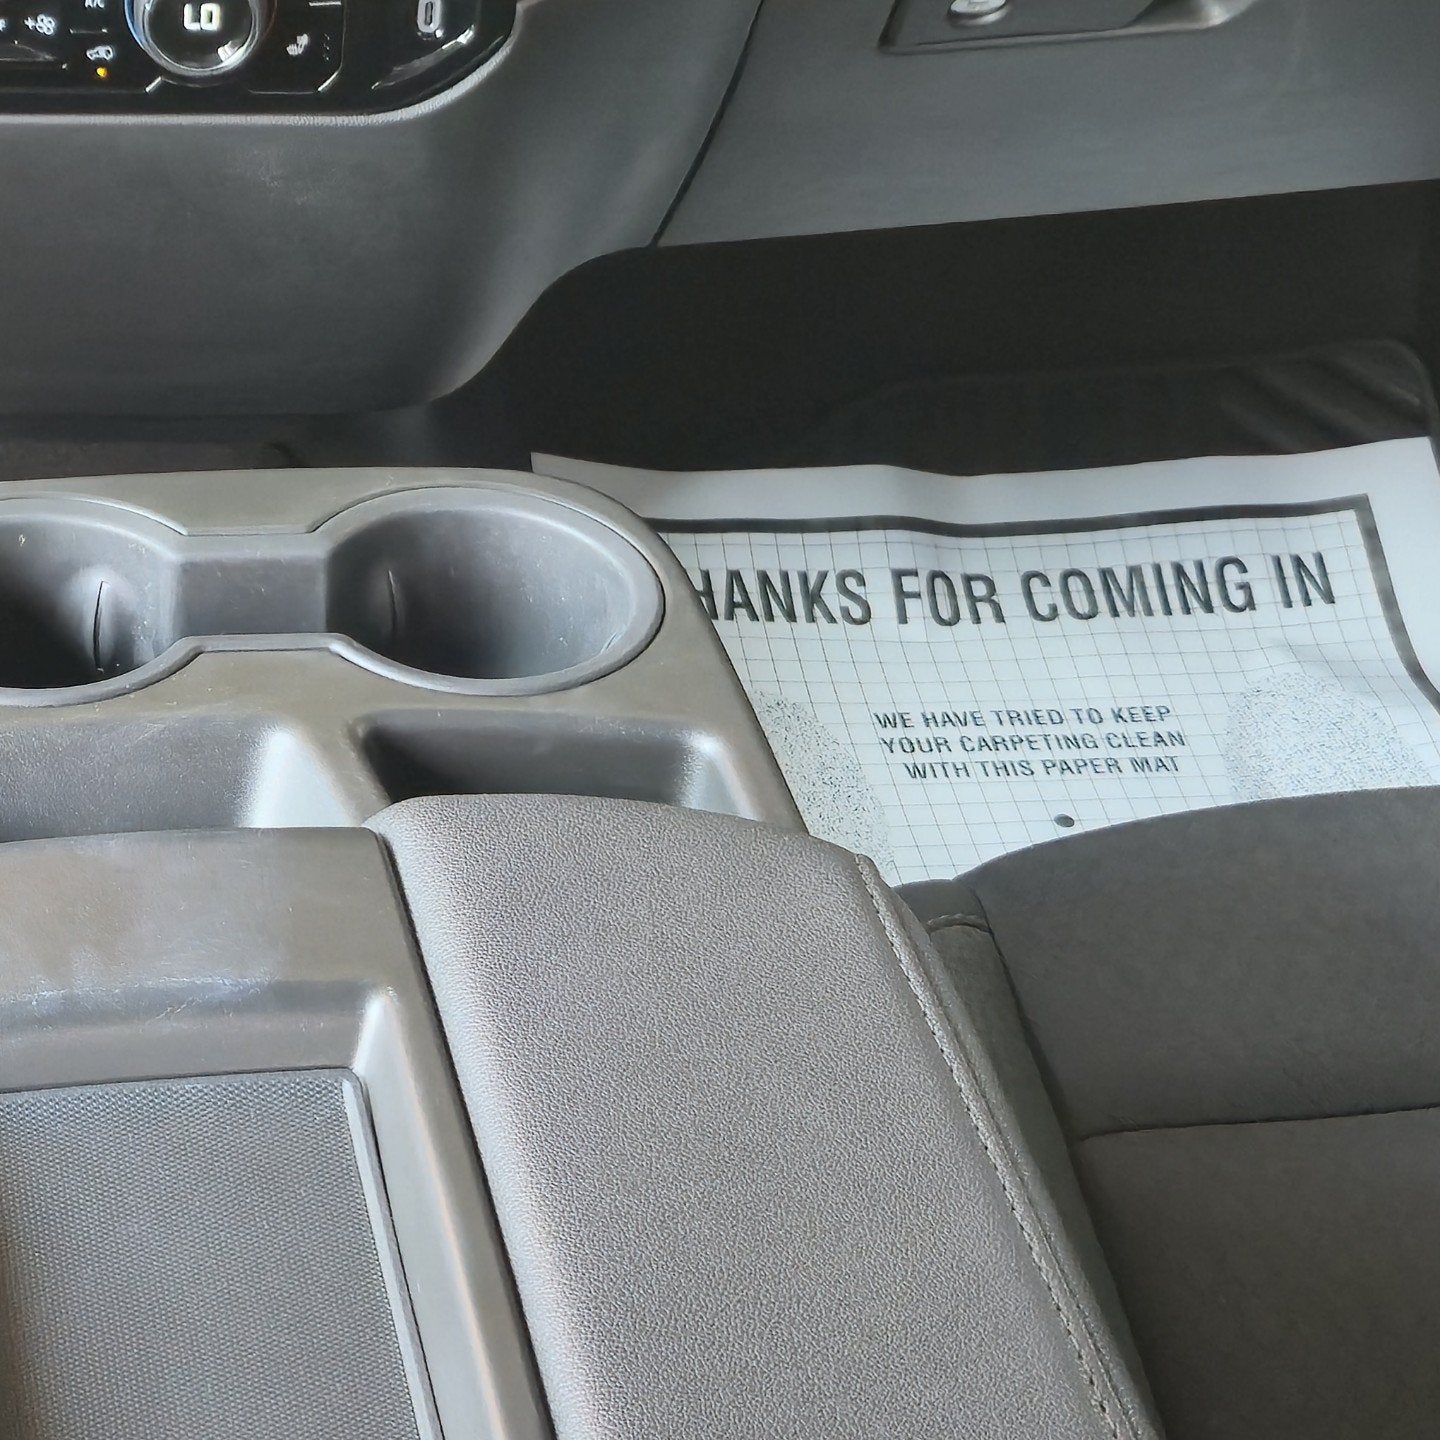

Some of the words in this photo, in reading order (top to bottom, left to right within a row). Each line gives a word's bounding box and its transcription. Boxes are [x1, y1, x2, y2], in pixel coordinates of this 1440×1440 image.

[183, 2, 221, 31] LO
[696, 568, 872, 626] HANKS
[889, 568, 1006, 627] FOR
[1020, 556, 1257, 622] COMING
[1270, 551, 1336, 608] IN
[873, 711, 915, 729] WE
[921, 709, 985, 729] HAVE
[993, 708, 1064, 728] TRIED
[1071, 707, 1104, 724] TO
[1111, 705, 1171, 724] KEEP
[880, 735, 952, 755] YOUR
[960, 732, 1098, 753] CARPETING
[1105, 729, 1187, 750] CLEAN
[904, 761, 970, 780] WITH
[974, 759, 1035, 778] THIS
[1041, 757, 1124, 777] PAPER
[1128, 755, 1180, 774] MAT
